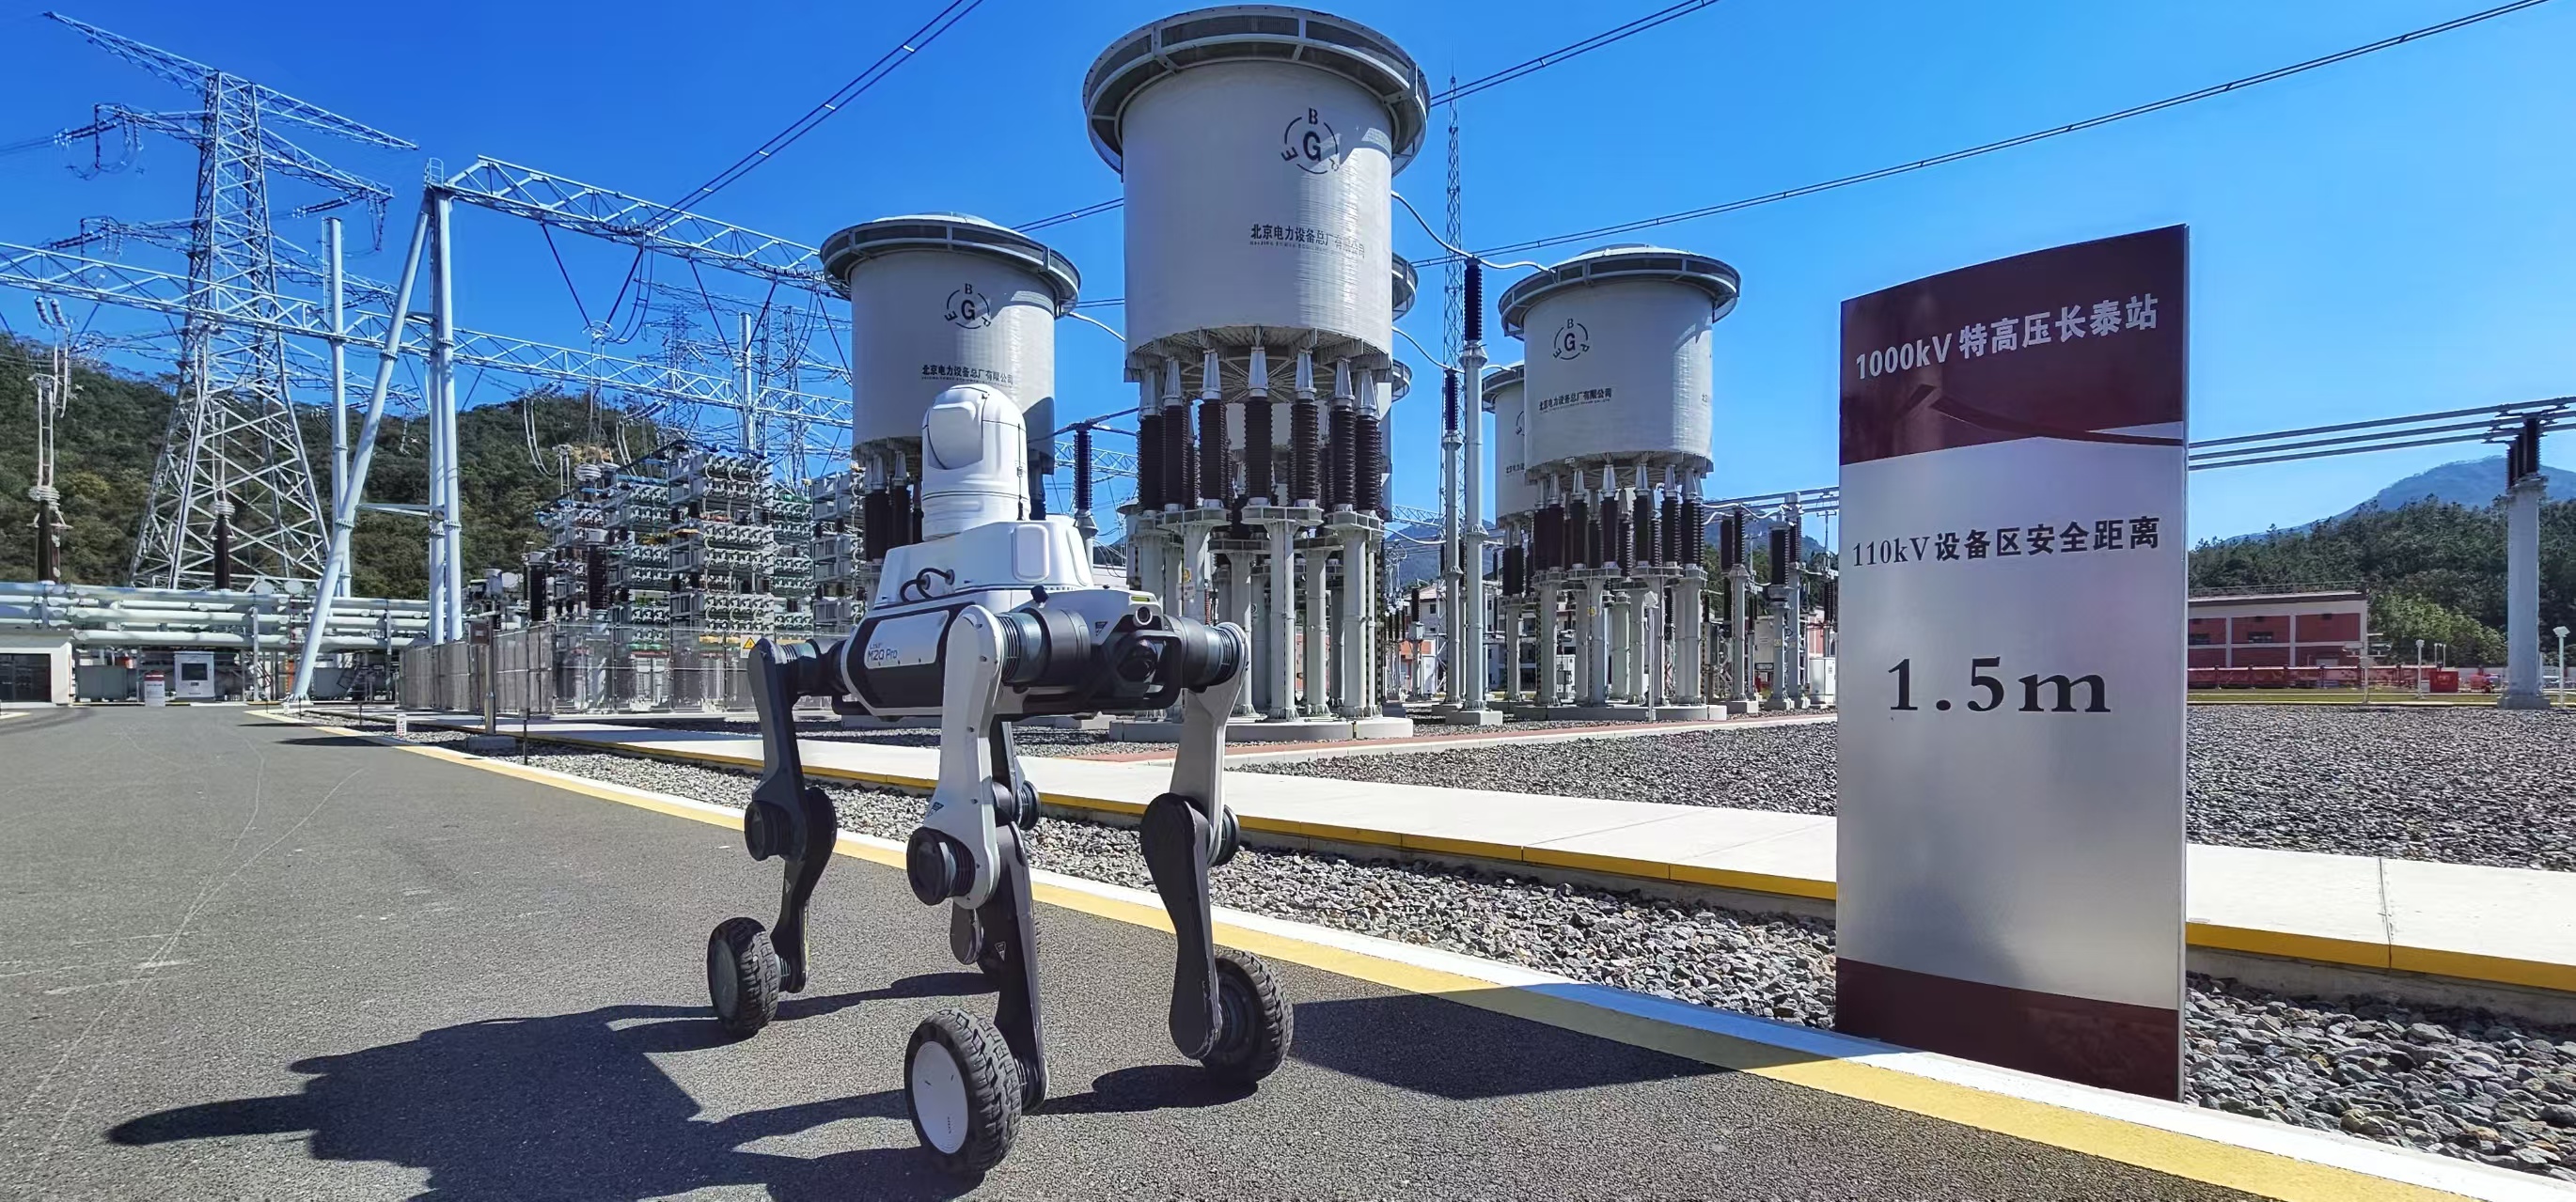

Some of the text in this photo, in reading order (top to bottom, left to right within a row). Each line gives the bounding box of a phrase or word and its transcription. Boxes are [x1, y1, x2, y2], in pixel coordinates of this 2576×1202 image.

[1308, 107, 1318, 125] B
[1280, 147, 1298, 162] E
[1303, 131, 1321, 162] G
[965, 283, 973, 294] B
[944, 310, 958, 321] E
[961, 300, 975, 320] G
[1567, 319, 1575, 329] B
[1563, 333, 1576, 351] G
[1856, 293, 2159, 380] 1000kV 特高压长泰站
[922, 365, 1013, 384] 北京电力设备总厂有限公司
[867, 648, 898, 661] M20 Pro
[1888, 656, 2111, 712] 1.5m
